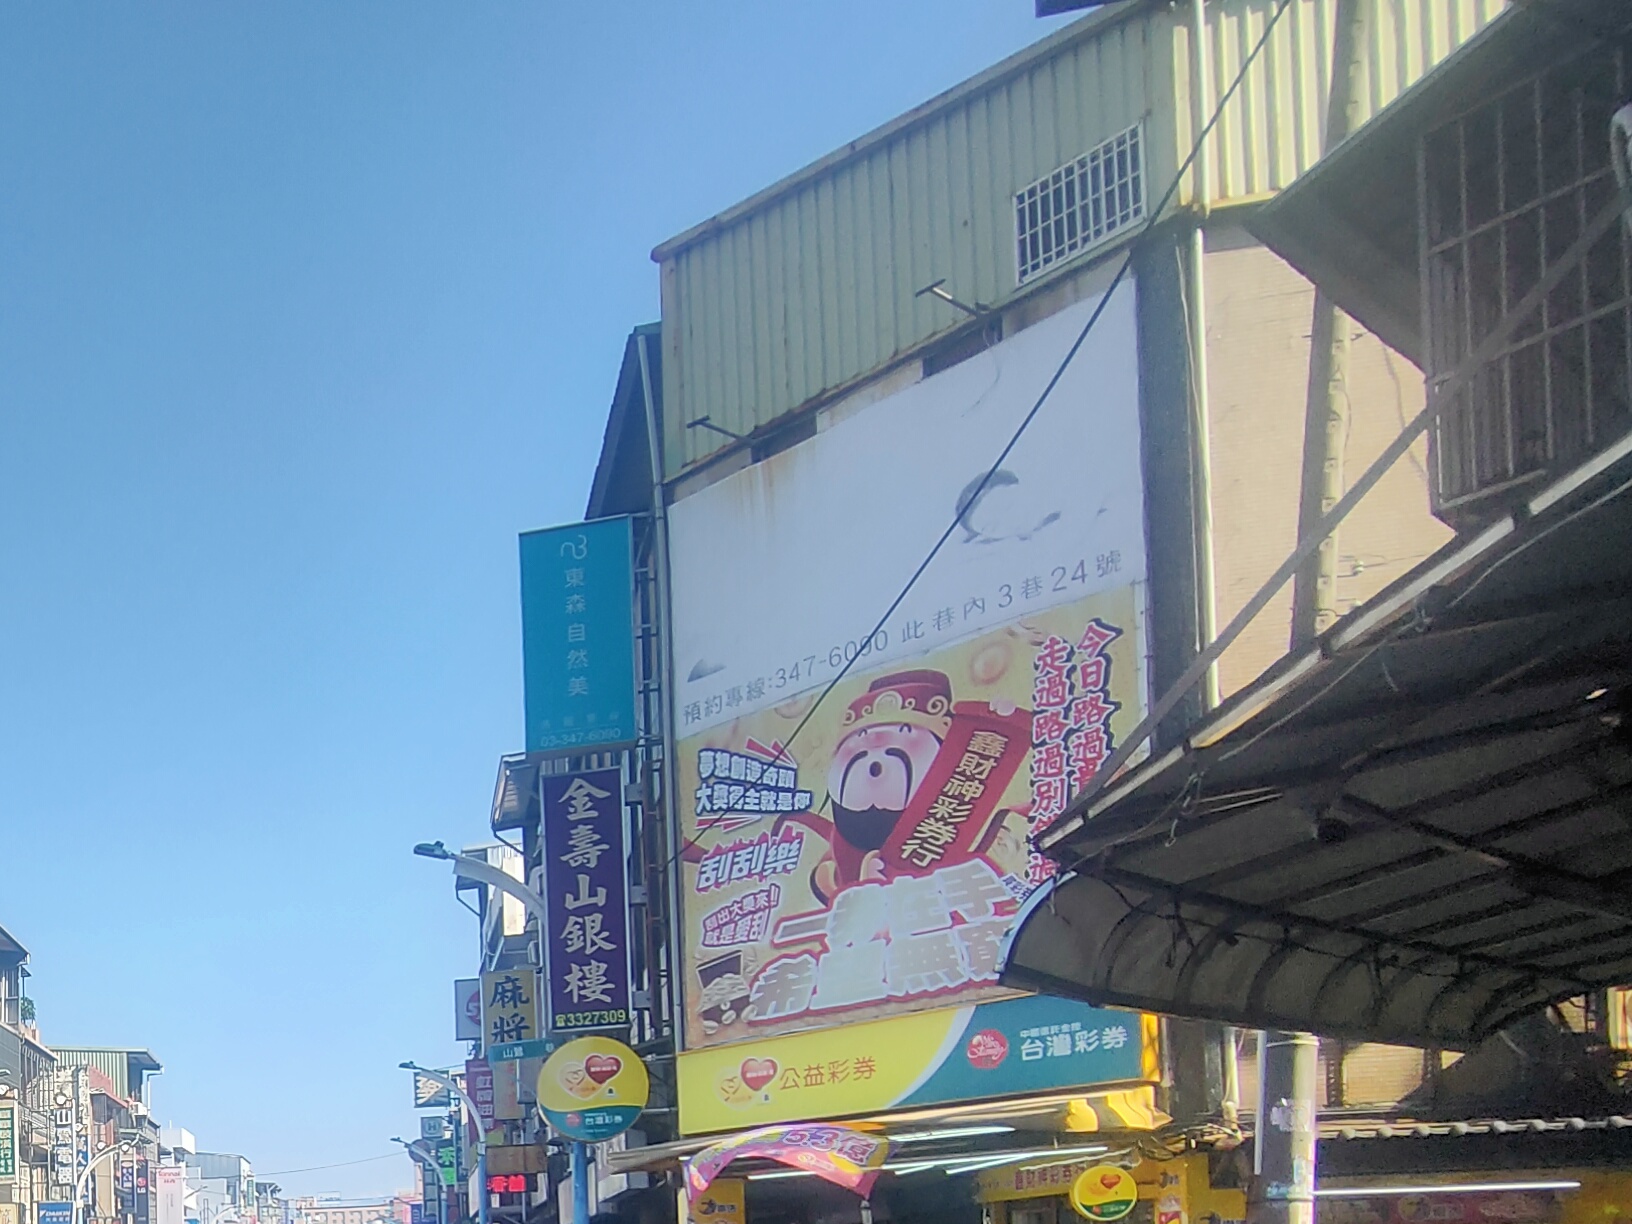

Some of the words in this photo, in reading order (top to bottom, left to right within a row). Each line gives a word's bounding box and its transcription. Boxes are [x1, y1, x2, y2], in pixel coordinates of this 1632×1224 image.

[564, 567, 589, 696] 東森自然美
[696, 784, 812, 815] 大獎得主就是你
[901, 730, 1009, 868] 鑫財神彩券行
[698, 837, 804, 890] 刮刮樂
[558, 778, 617, 1004] 金壽山銀樓
[490, 975, 530, 1043] 麻將
[567, 1009, 626, 1026] 3327309
[1021, 1025, 1128, 1061] 台灣彩券
[780, 1056, 877, 1090] 公益彩券
